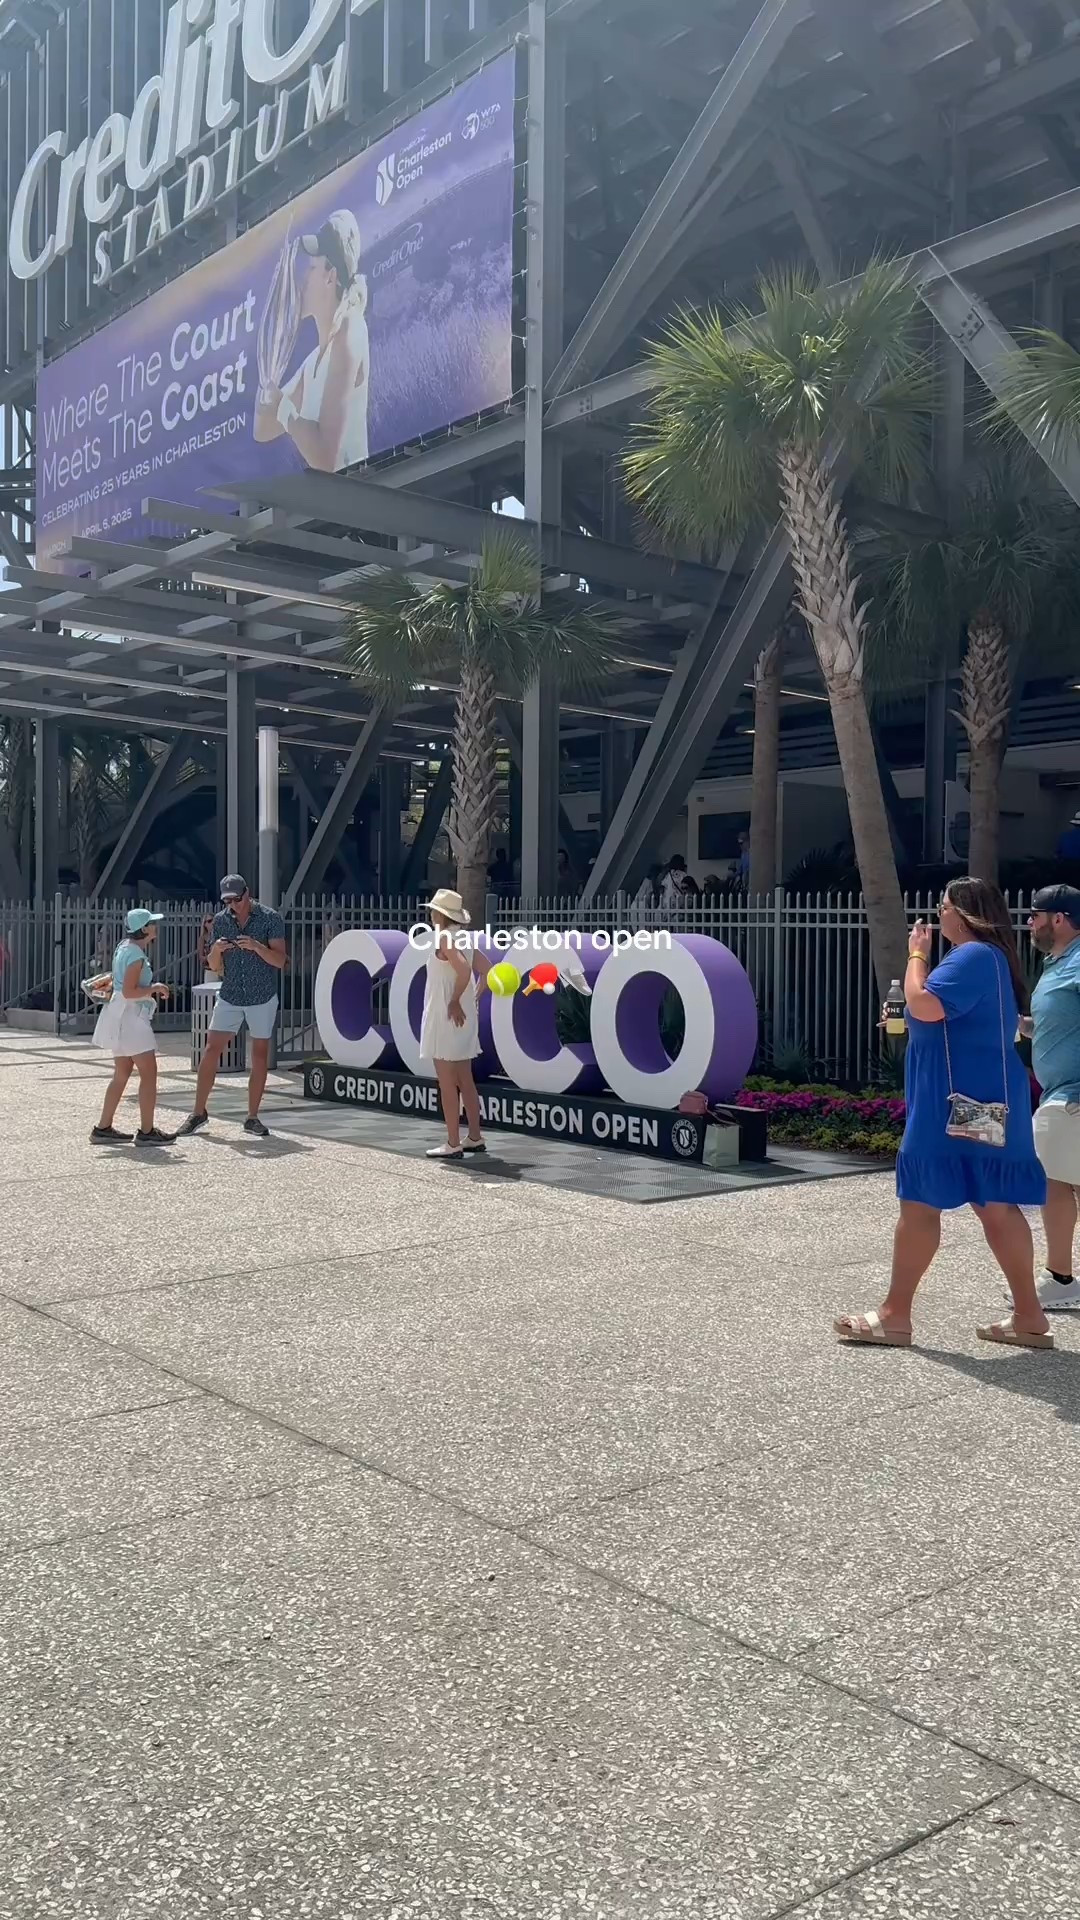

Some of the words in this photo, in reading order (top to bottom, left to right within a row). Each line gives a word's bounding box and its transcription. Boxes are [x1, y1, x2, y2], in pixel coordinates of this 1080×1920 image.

[93, 41, 349, 286] STADIUM
[396, 164, 424, 189] Open
[397, 131, 453, 175] Charleston
[42, 381, 110, 449] Where
[117, 350, 163, 403] The
[170, 288, 257, 372] Court
[41, 485, 100, 527] CELEBRATING
[100, 478, 115, 497] 25
[115, 460, 151, 487] YEARS
[151, 451, 164, 471] IN
[165, 412, 248, 464] CHARLESTON
[42, 436, 102, 499] Meets
[108, 408, 153, 459] The
[160, 350, 248, 431] Coast
[81, 523, 103, 538] APRIL
[111, 507, 133, 527] 2025
[334, 1073, 396, 1105] CREDIT
[399, 1083, 438, 1112] ONE
[592, 1111, 659, 1147] OPEN
